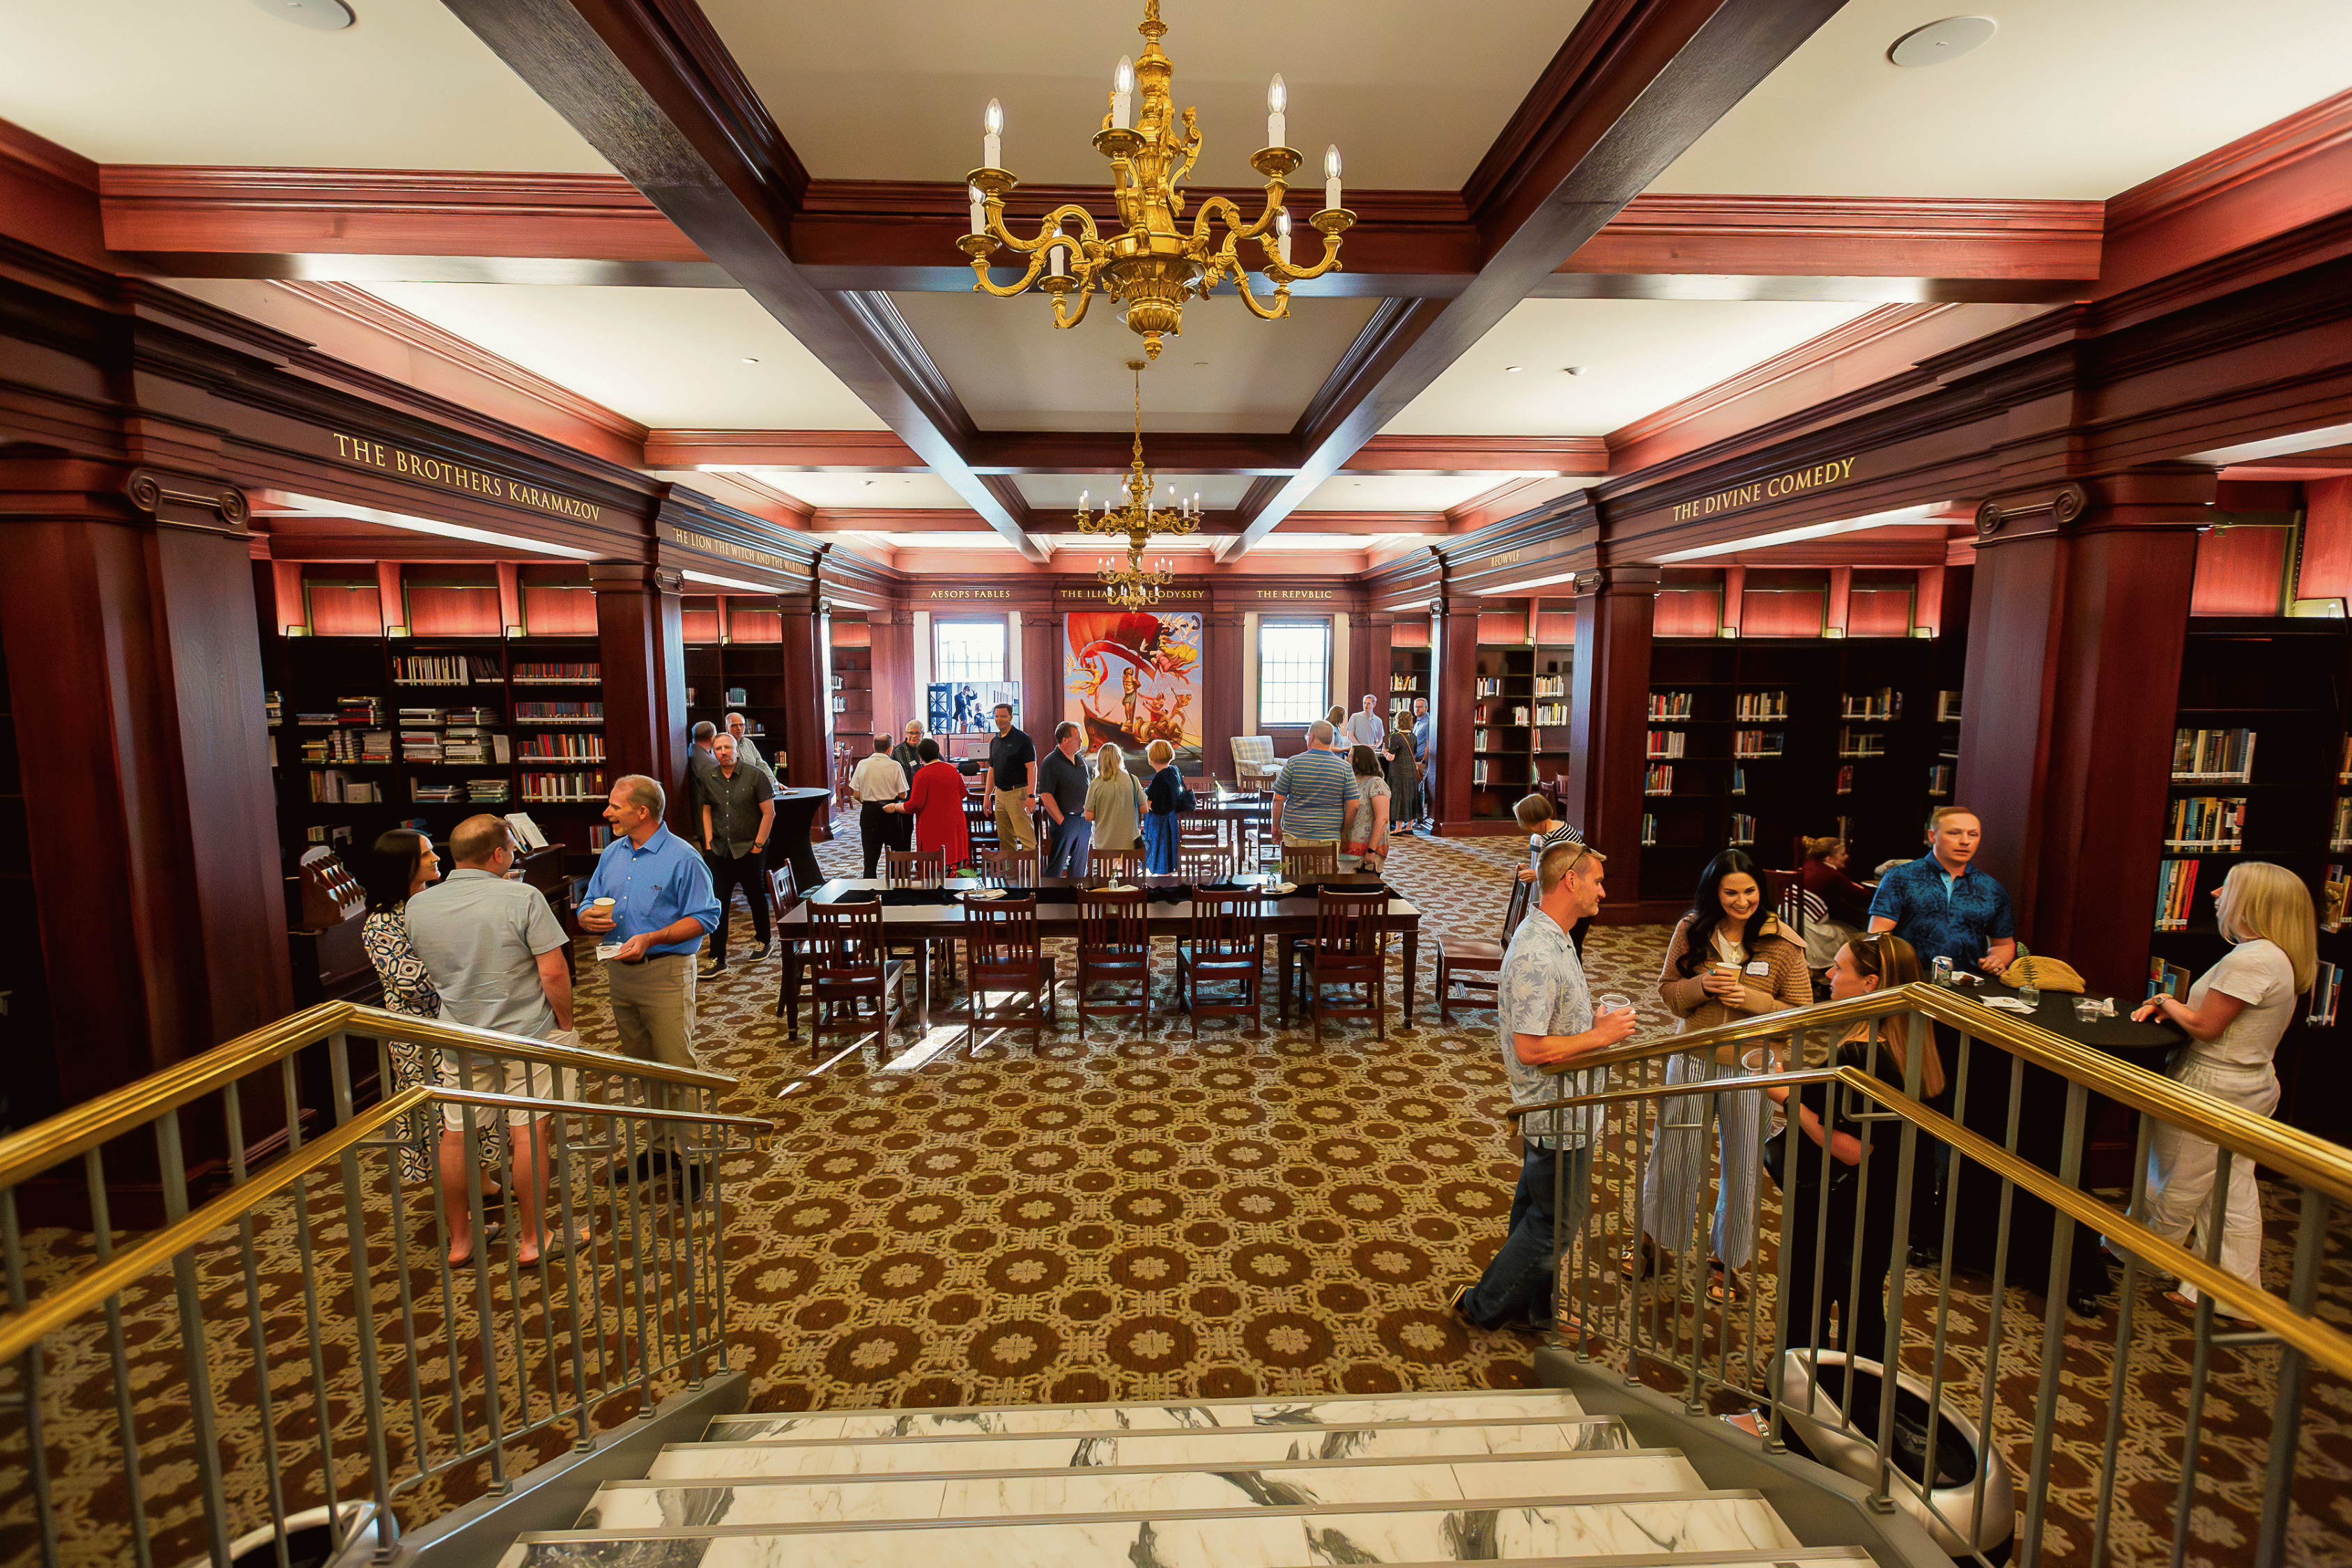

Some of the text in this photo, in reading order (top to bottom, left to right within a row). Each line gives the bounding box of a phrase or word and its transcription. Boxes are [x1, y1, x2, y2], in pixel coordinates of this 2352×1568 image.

[333, 433, 599, 521] THE BROTHERS KARAMAZOV
[1673, 457, 1856, 521] THE DIVINE COMEDY
[672, 528, 688, 544] HE
[691, 533, 712, 551] LION
[714, 539, 729, 555] THE
[731, 544, 755, 561] WITCH
[757, 552, 770, 565] AND
[771, 555, 783, 569] THE
[1282, 590, 1332, 599] REPVBLIC
